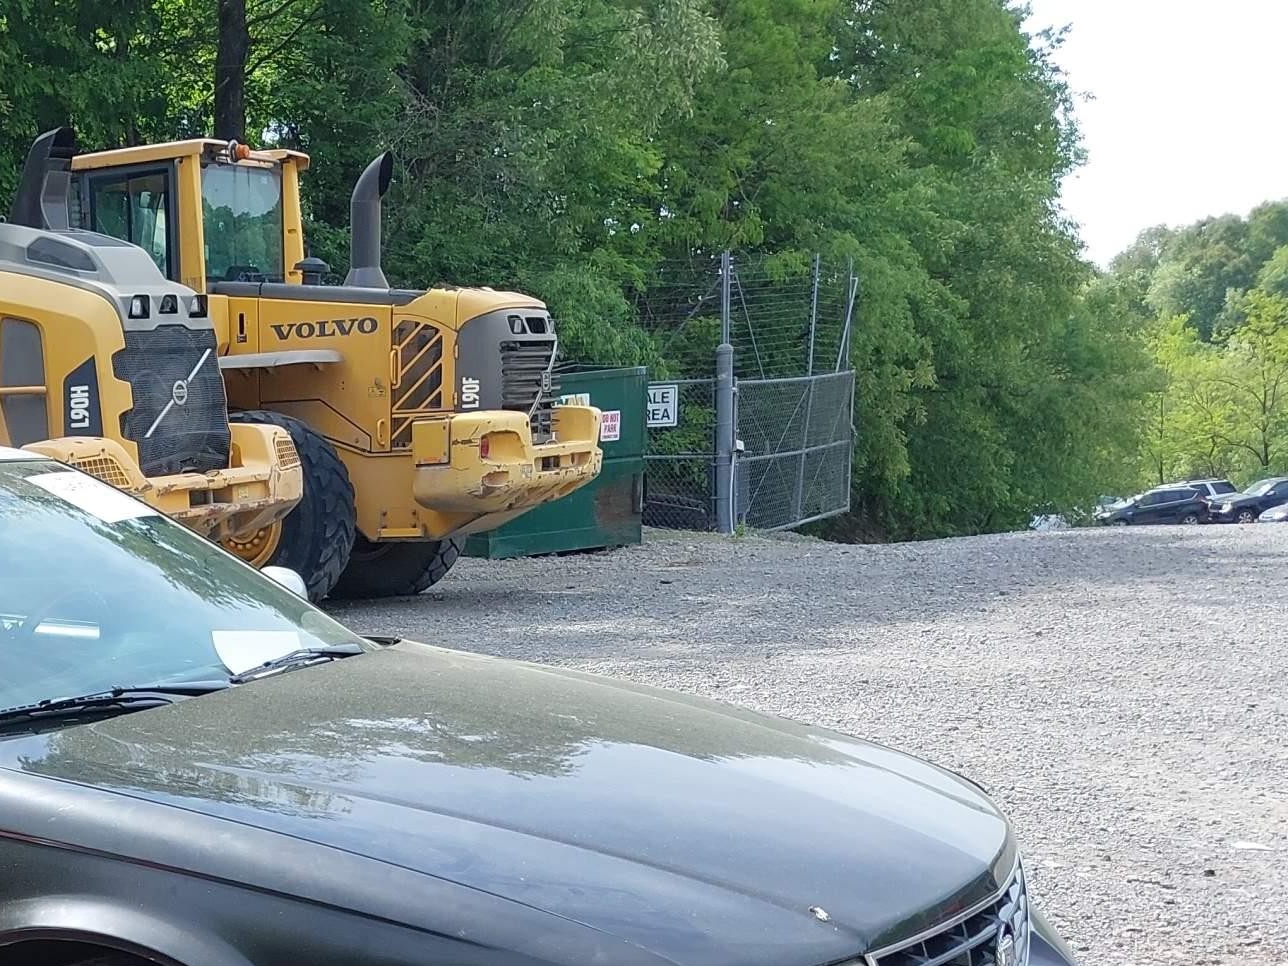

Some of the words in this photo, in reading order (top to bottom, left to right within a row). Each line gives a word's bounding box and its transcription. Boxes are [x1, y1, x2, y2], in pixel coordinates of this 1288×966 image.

[271, 317, 378, 340] VOLVO
[461, 377, 480, 408] L90F
[70, 385, 90, 428] L90H
[604, 424, 617, 433] PARK
